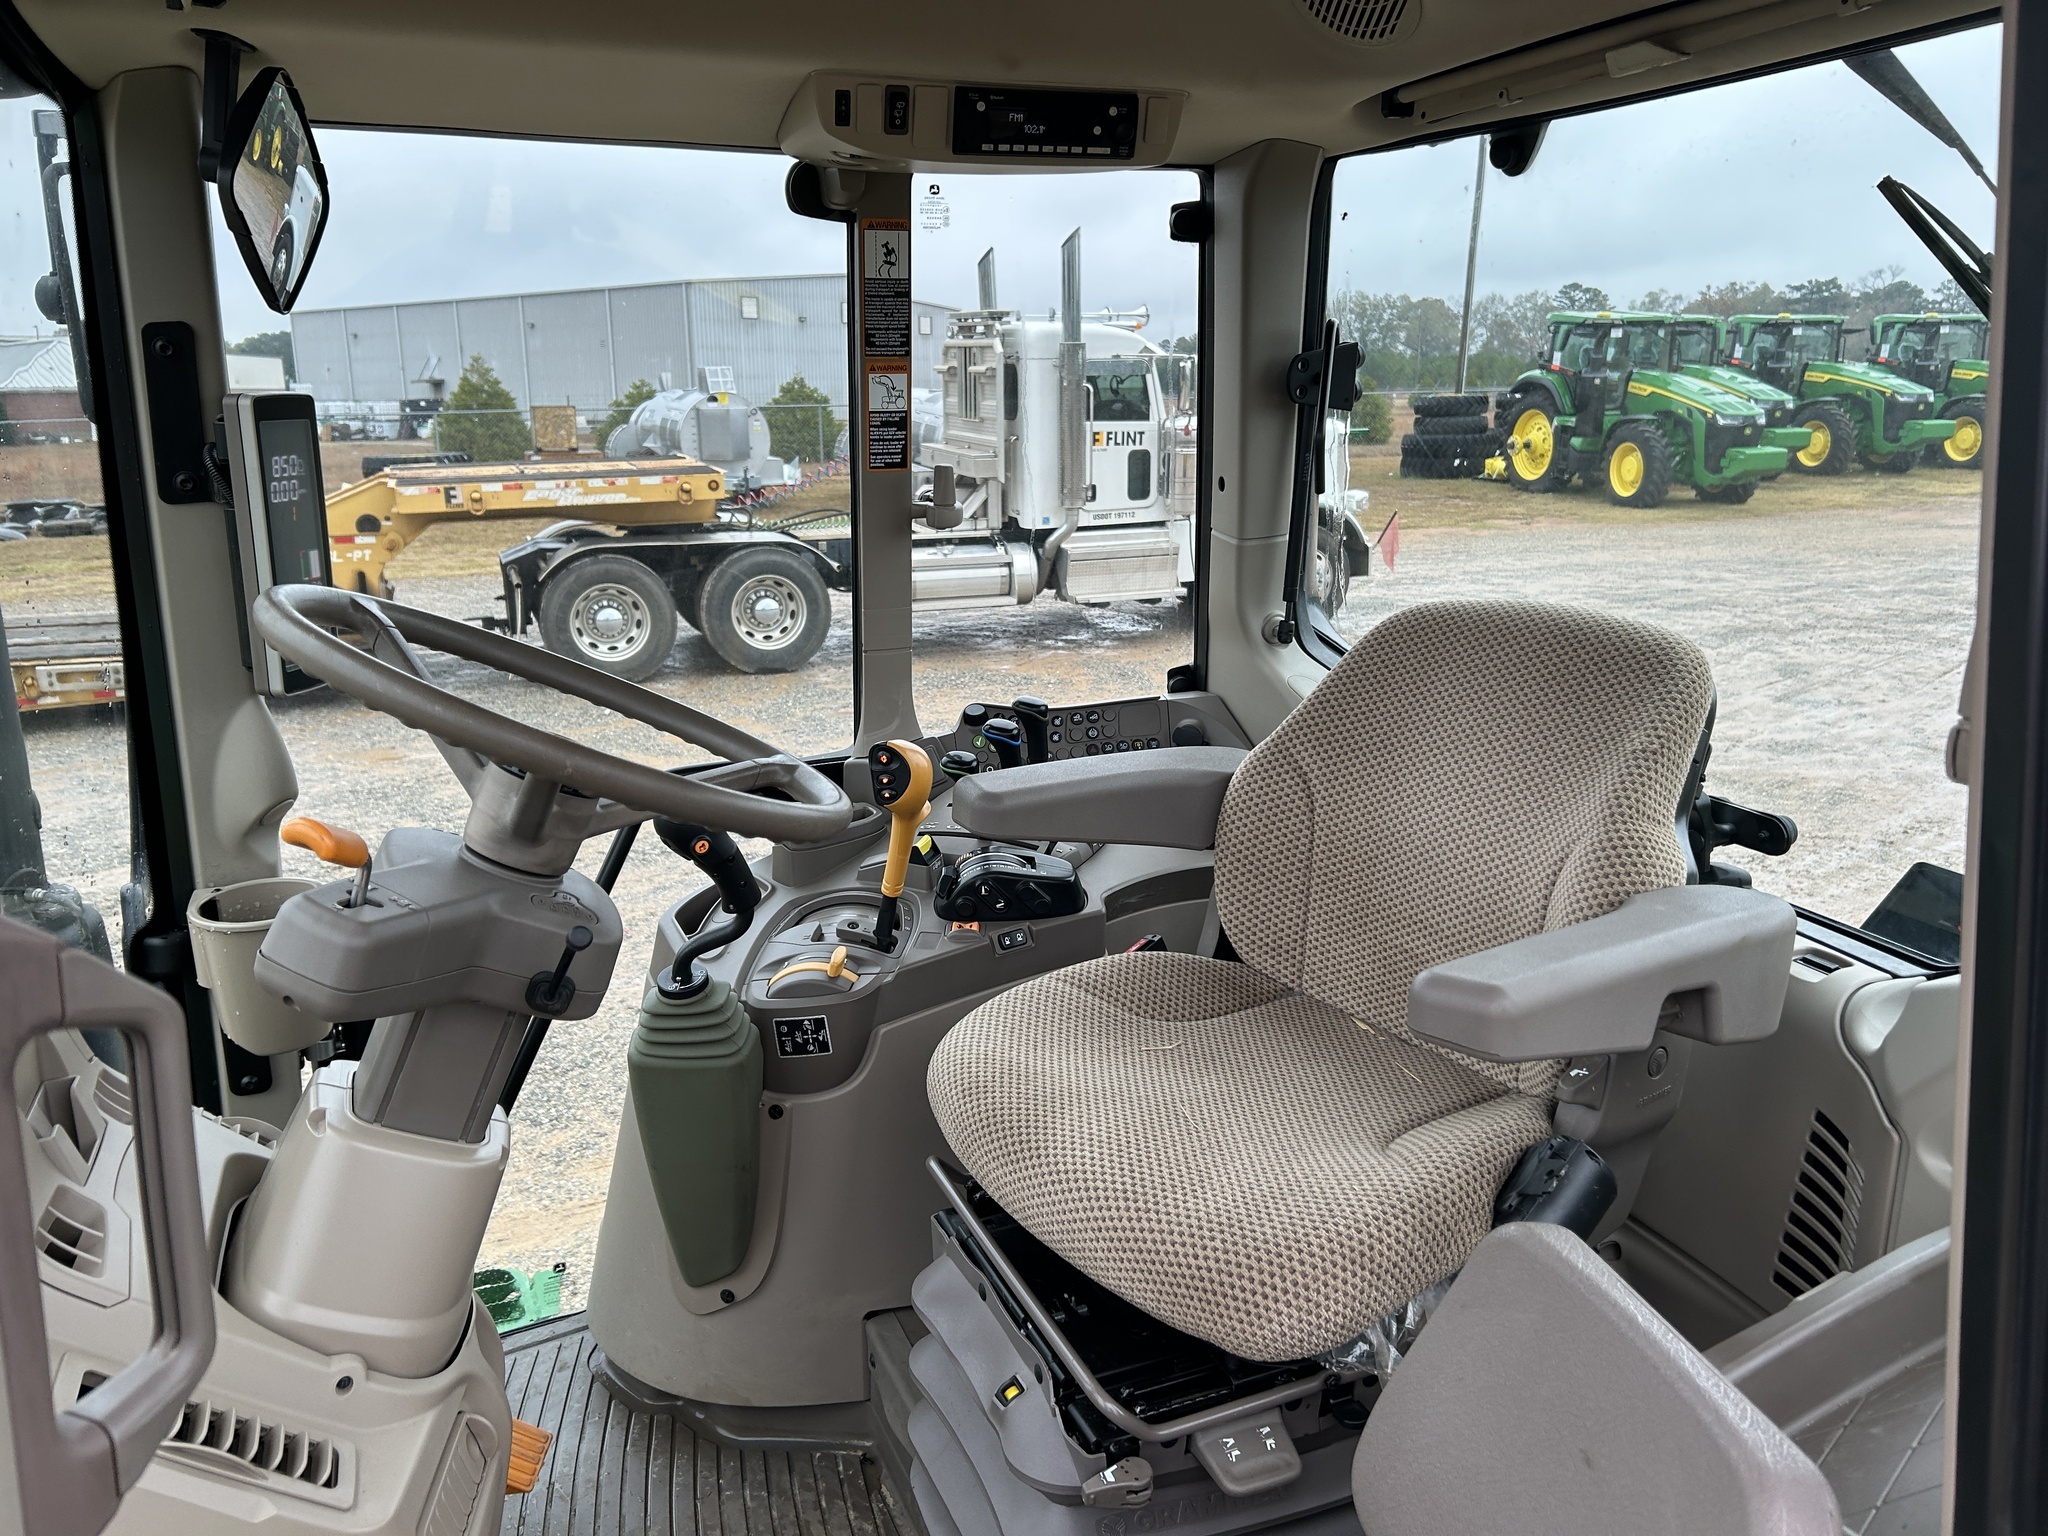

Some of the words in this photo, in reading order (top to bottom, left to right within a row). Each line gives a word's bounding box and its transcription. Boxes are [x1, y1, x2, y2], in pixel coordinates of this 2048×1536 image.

[874, 221, 908, 229] WARNING
[1106, 431, 1145, 446] FLINT
[272, 455, 298, 478] 850
[271, 480, 298, 503] 0.00
